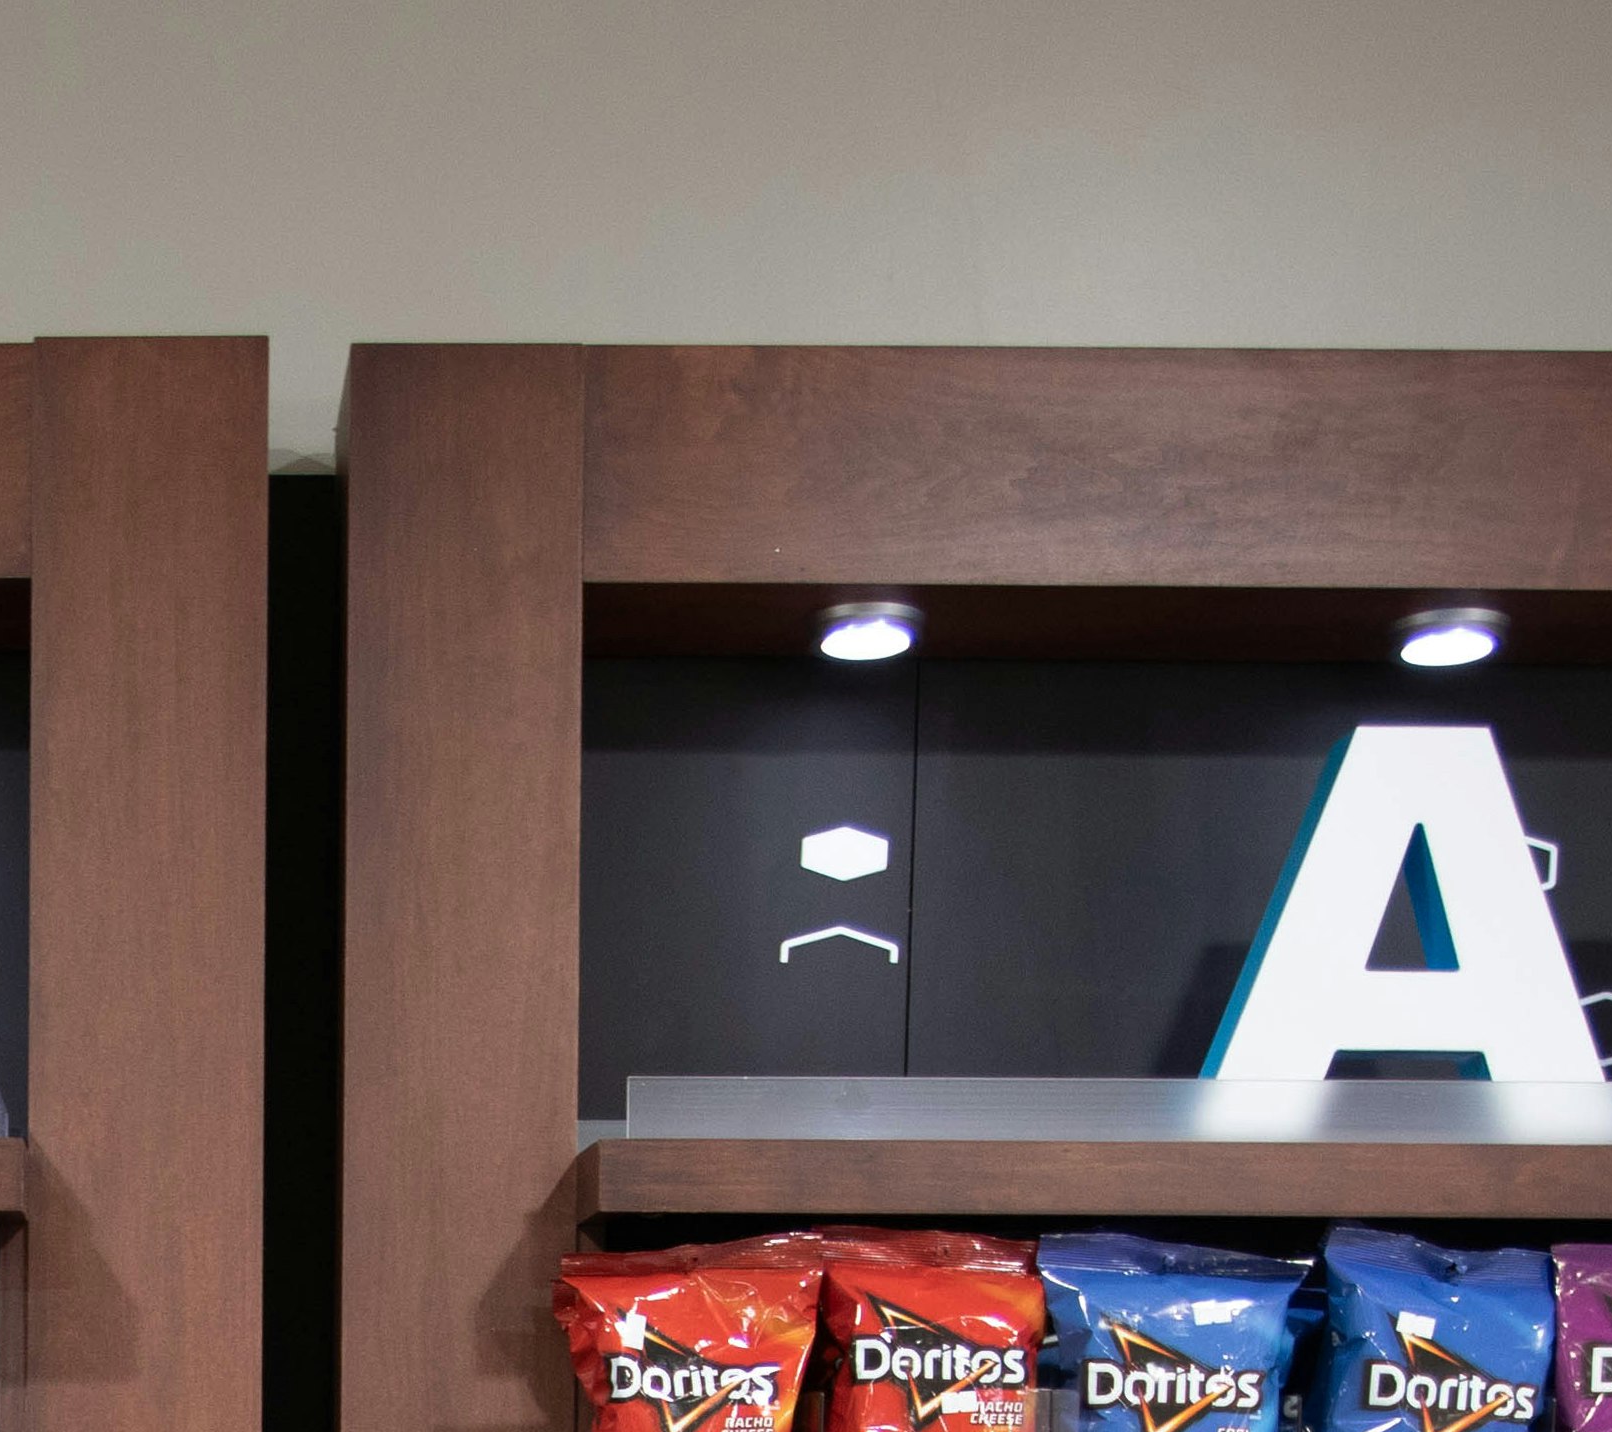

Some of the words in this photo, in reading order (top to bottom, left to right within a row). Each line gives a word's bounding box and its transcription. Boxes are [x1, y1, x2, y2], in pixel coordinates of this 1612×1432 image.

[609, 1356, 782, 1402] Doritos
[853, 1338, 1025, 1384] Doritos
[1087, 1362, 1261, 1408] Doritos
[1368, 1363, 1536, 1420] Doritos
[724, 1416, 774, 1429] NACHO
[970, 1413, 1024, 1424] CHEESE
